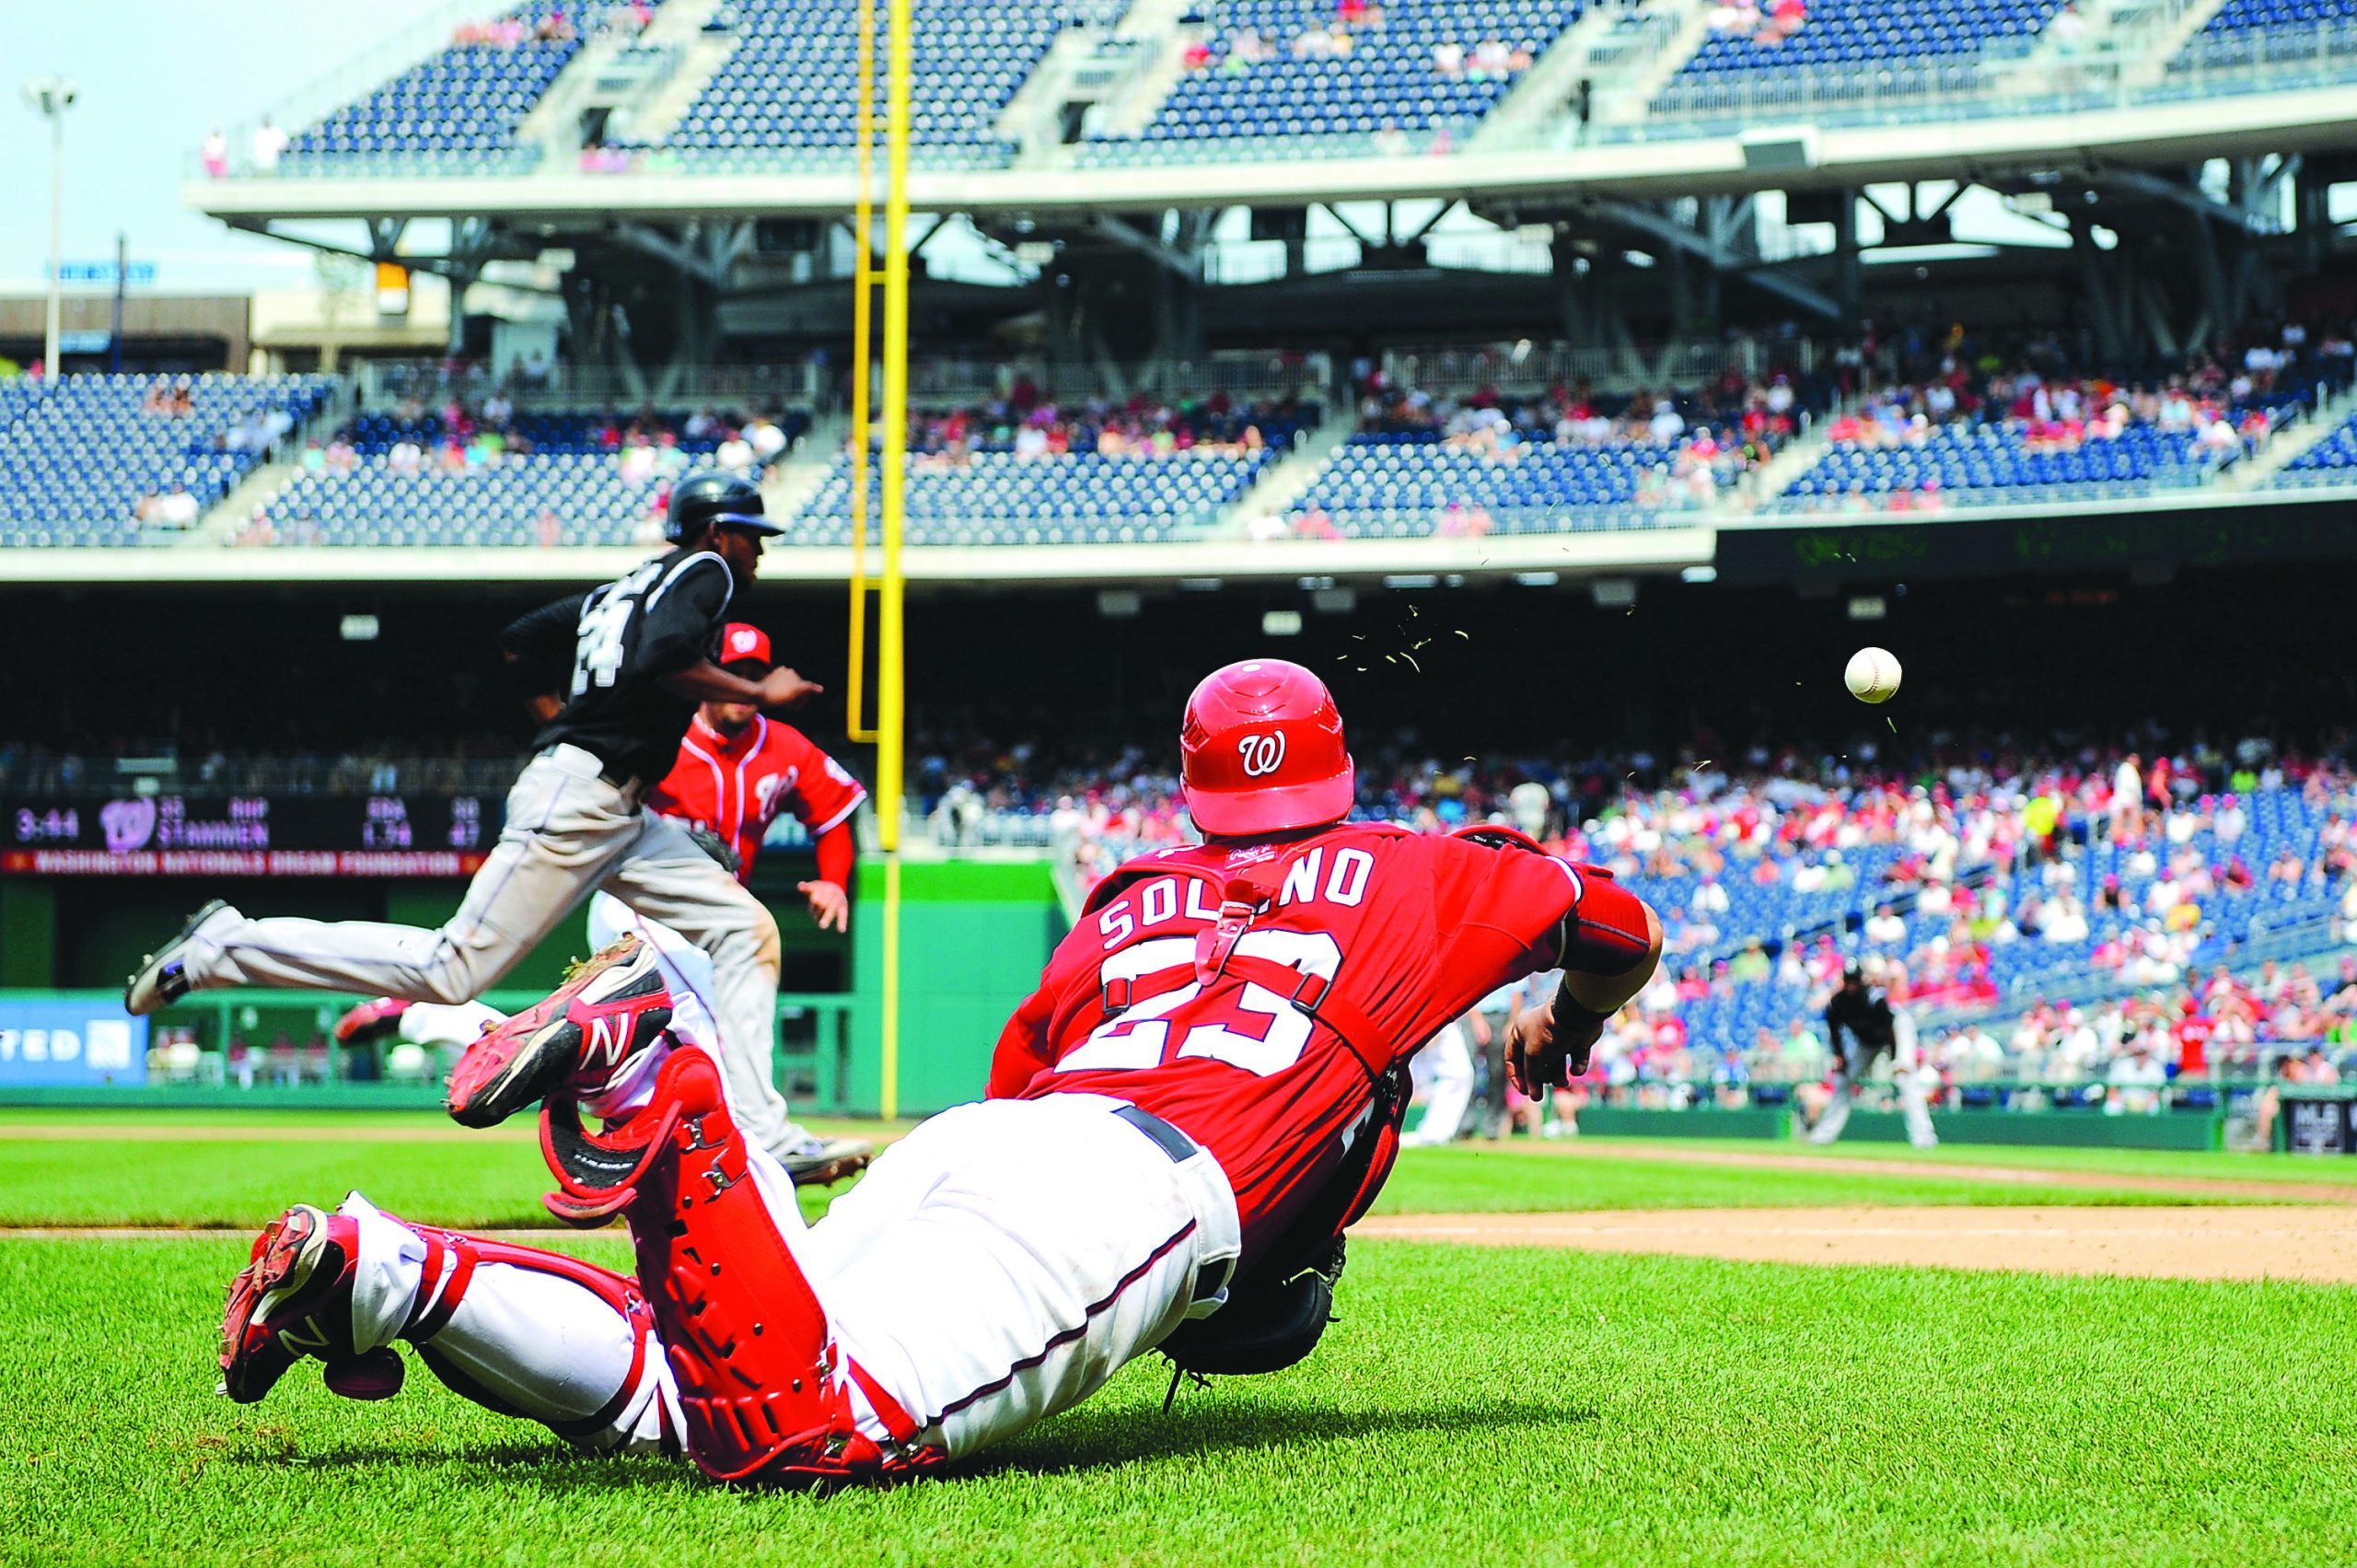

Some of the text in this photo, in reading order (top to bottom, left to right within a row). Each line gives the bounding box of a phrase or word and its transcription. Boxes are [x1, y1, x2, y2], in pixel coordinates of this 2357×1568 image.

[1237, 729, 1286, 777] W
[1098, 845, 1375, 952] SOLNO
[1052, 930, 1344, 1078] 23
